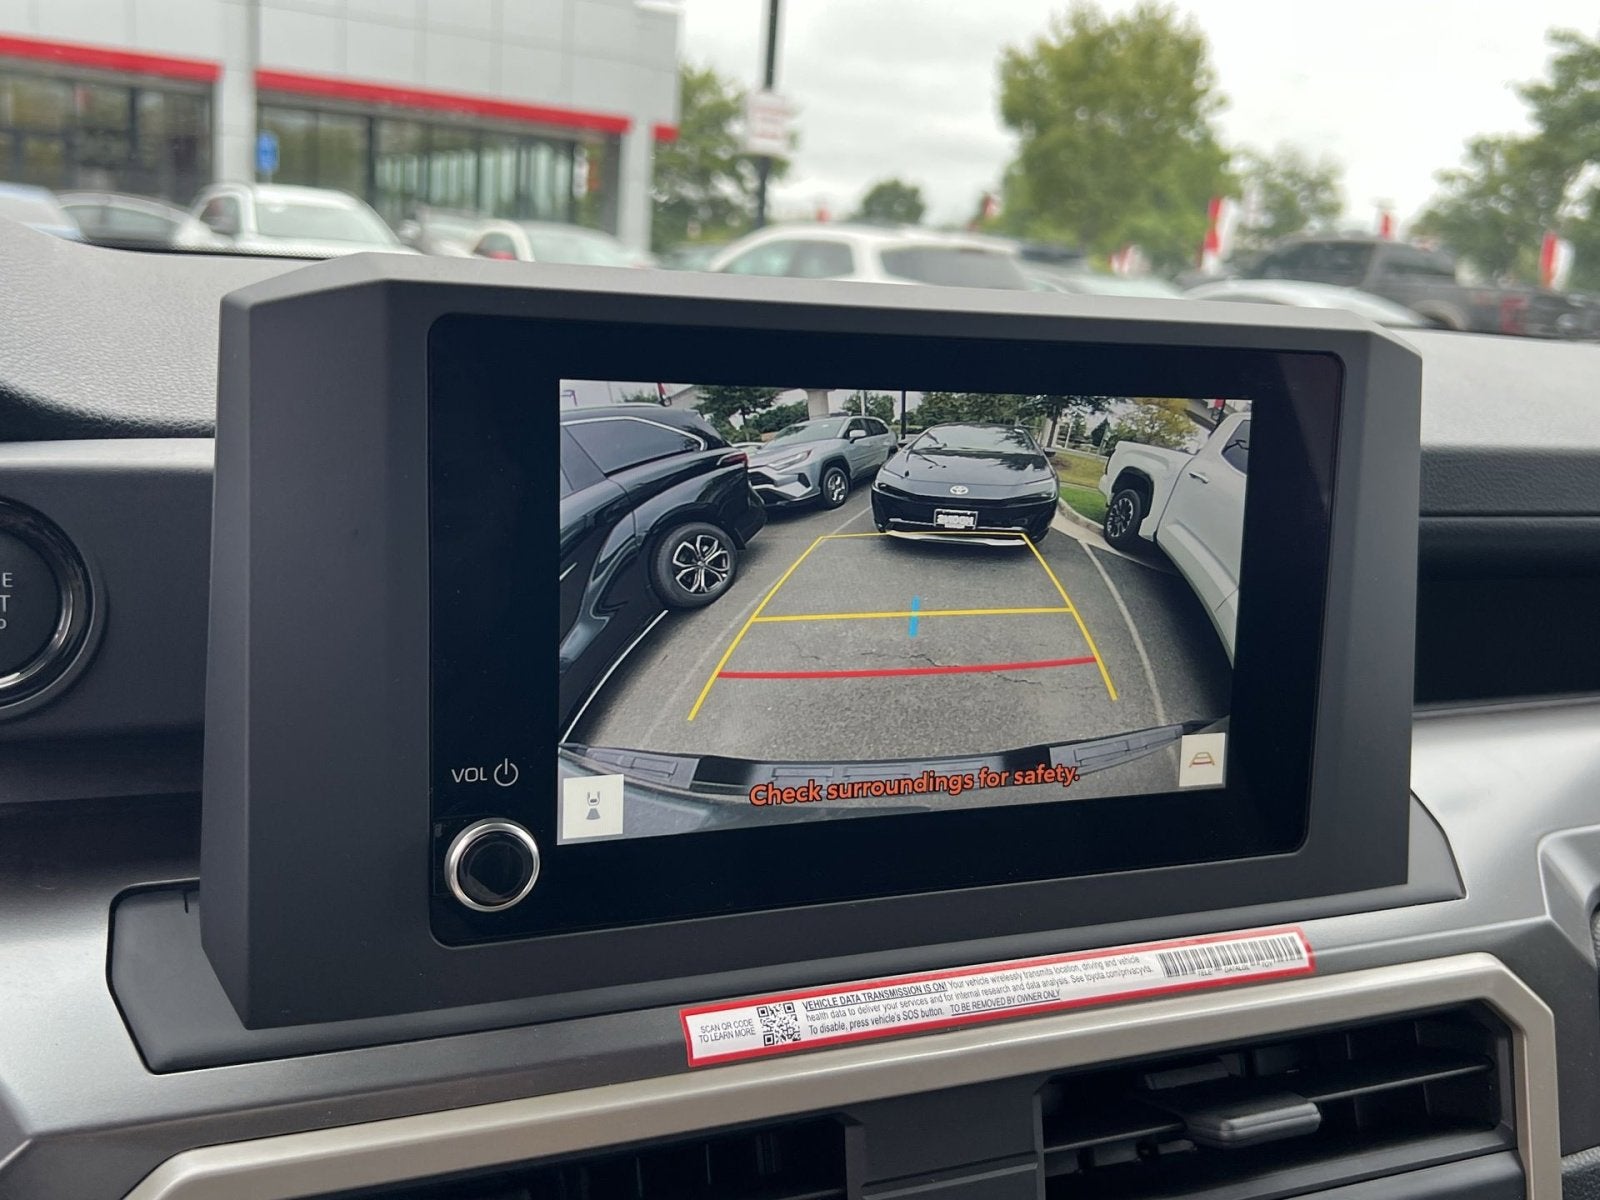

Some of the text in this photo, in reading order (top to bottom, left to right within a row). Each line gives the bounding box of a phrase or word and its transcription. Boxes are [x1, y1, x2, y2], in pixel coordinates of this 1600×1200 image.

[451, 767, 488, 783] VOL
[749, 763, 1081, 806] Check surroundings for safety.
[802, 996, 839, 1010] VEHICLE
[840, 994, 861, 1004] DATA
[862, 984, 922, 1001] TRANSMISSION
[923, 984, 932, 993] IS
[933, 981, 946, 991] ON!
[948, 980, 965, 989] Your
[965, 977, 989, 987] vehicle
[990, 972, 1022, 983] wirelessly
[1022, 967, 1053, 978] transmits
[1082, 961, 1105, 971] driving
[1104, 958, 1117, 967] and
[1117, 955, 1140, 965] vehicle
[806, 1011, 829, 1022] health
[830, 1008, 846, 1018] data
[848, 1007, 856, 1016] to
[858, 1004, 880, 1015] deliver
[882, 1002, 898, 1013] your
[900, 997, 929, 1008] services
[929, 995, 943, 1004] and
[944, 992, 953, 1001] for
[955, 989, 980, 1000] internal
[981, 984, 1011, 996] research
[1011, 982, 1025, 992] and
[1025, 980, 1040, 990] data
[1070, 974, 1084, 983] See
[950, 989, 1060, 1013] TO BE REMOVED BY OWNER ONLY
[699, 1026, 756, 1043] TO LEARN MORE
[700, 1018, 754, 1034] SCAN QR CODE
[809, 1024, 818, 1035] To
[820, 1021, 848, 1033] disable,
[849, 1018, 870, 1031] press
[870, 1012, 901, 1025] vehicle's
[902, 1009, 919, 1020] SOS
